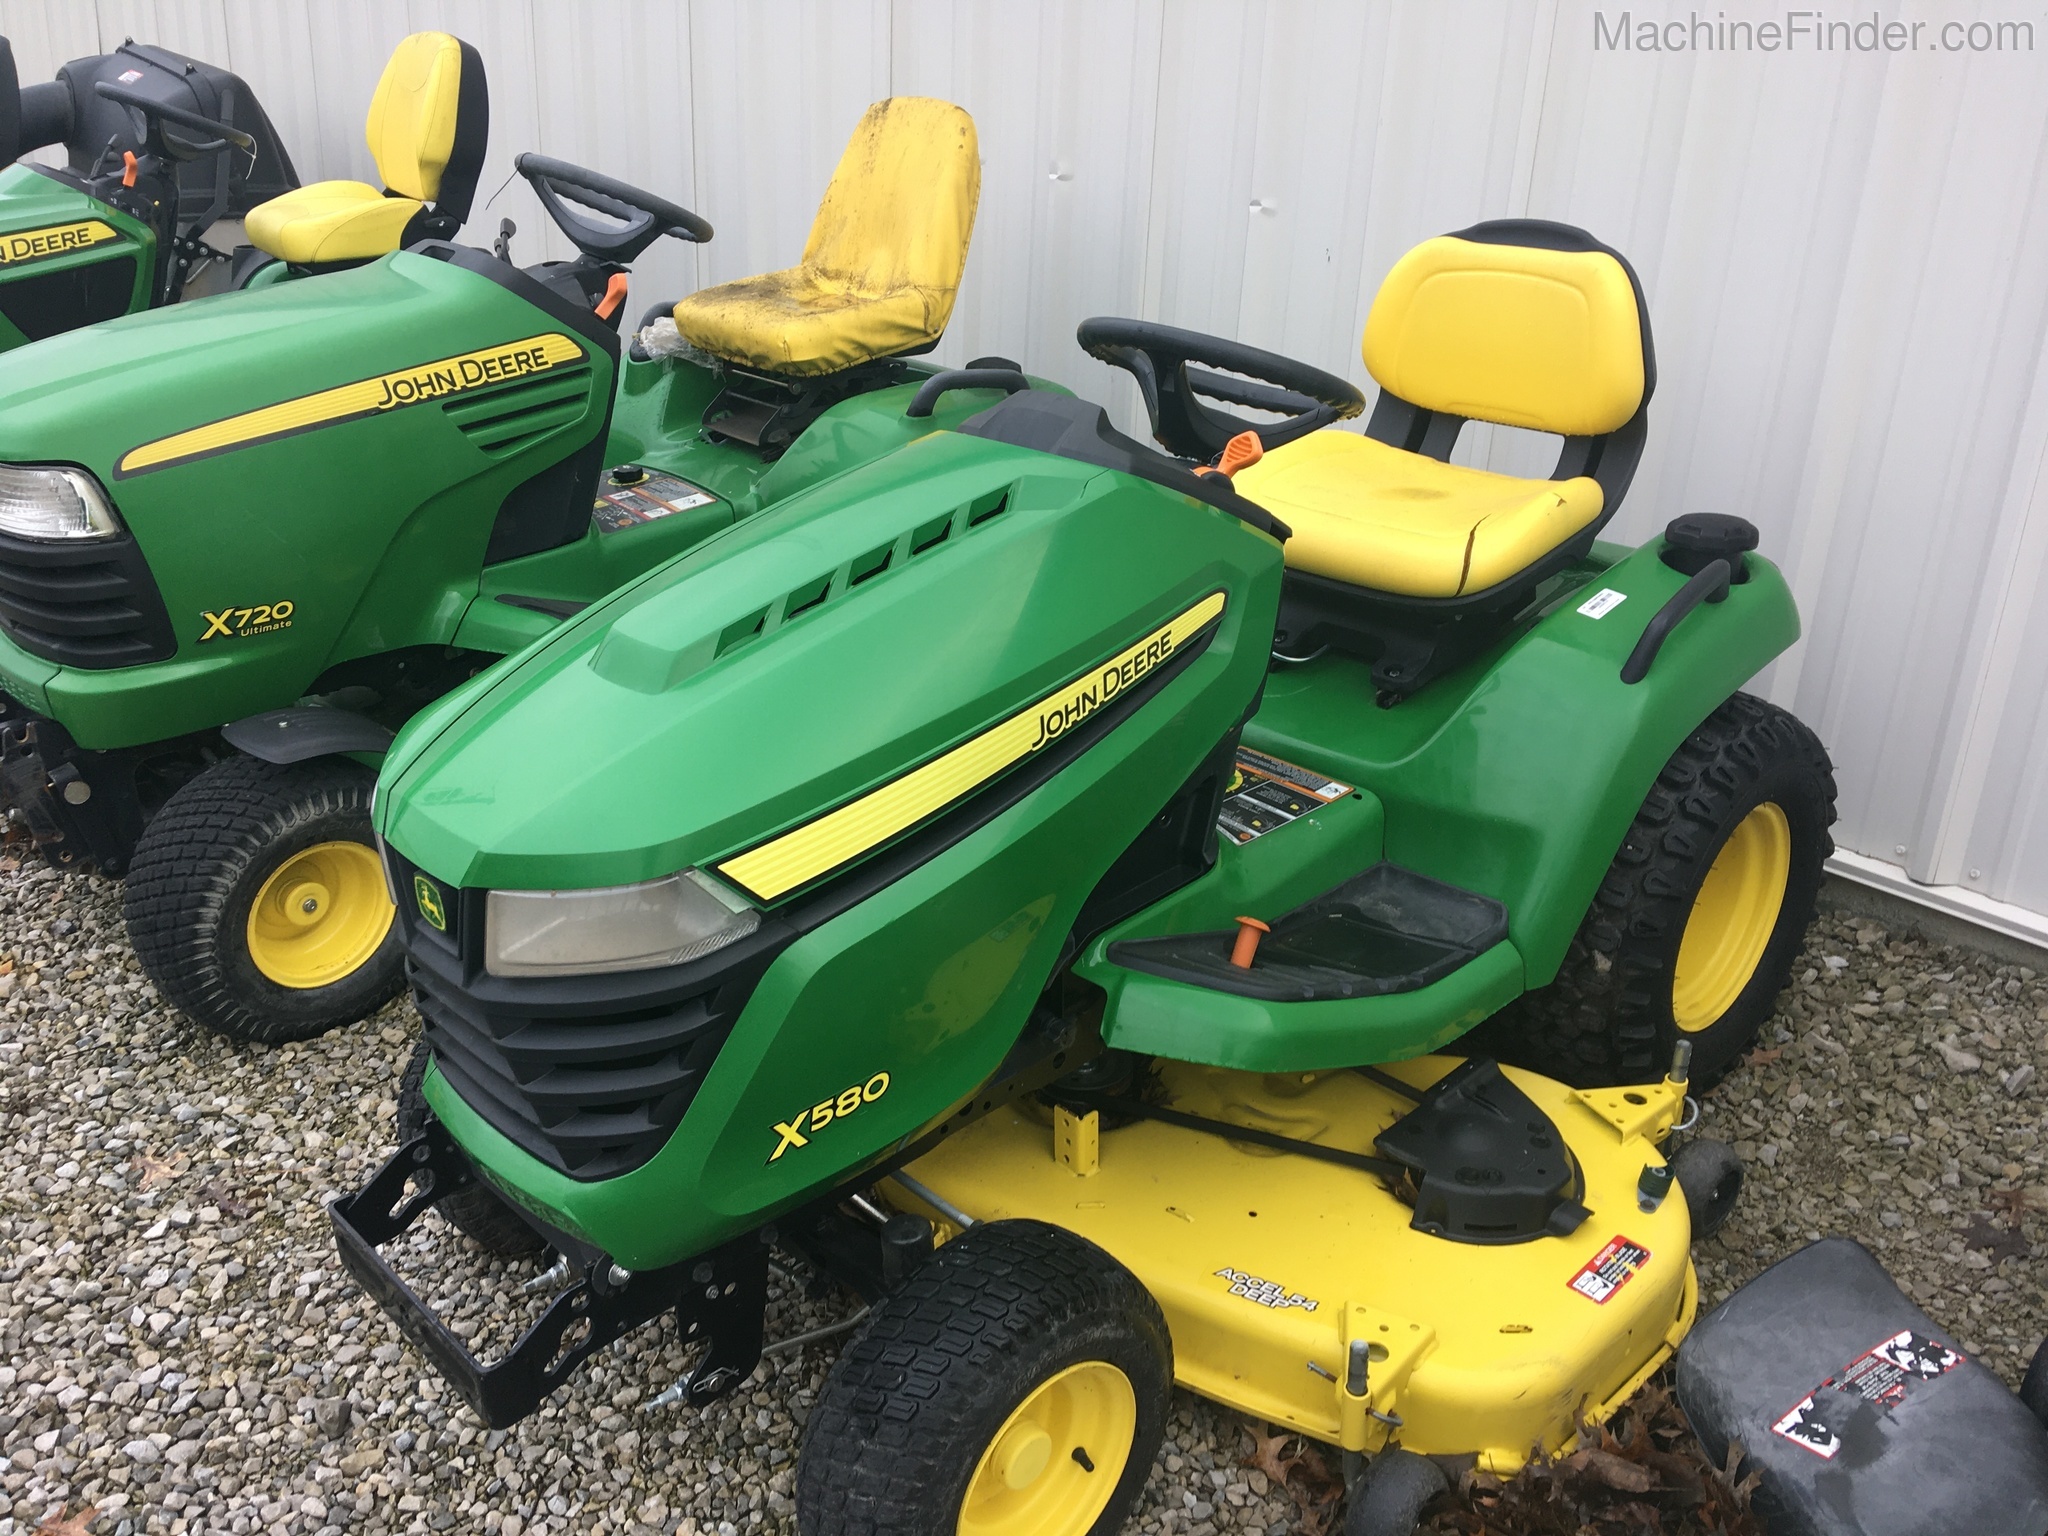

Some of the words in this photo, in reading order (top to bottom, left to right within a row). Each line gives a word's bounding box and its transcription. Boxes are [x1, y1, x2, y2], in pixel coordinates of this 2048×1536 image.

[10, 227, 92, 258] DEERE
[377, 368, 458, 406] JOHN
[458, 346, 549, 384] DEERE
[198, 600, 294, 641] X720
[240, 620, 292, 637] Ultimate
[1031, 684, 1098, 749] JOHN
[1102, 629, 1173, 700] DEERE
[767, 1071, 890, 1163] X580
[1212, 1266, 1287, 1300] ACCEL
[1287, 1293, 1320, 1312] 54
[1226, 1282, 1291, 1309] DEEP
